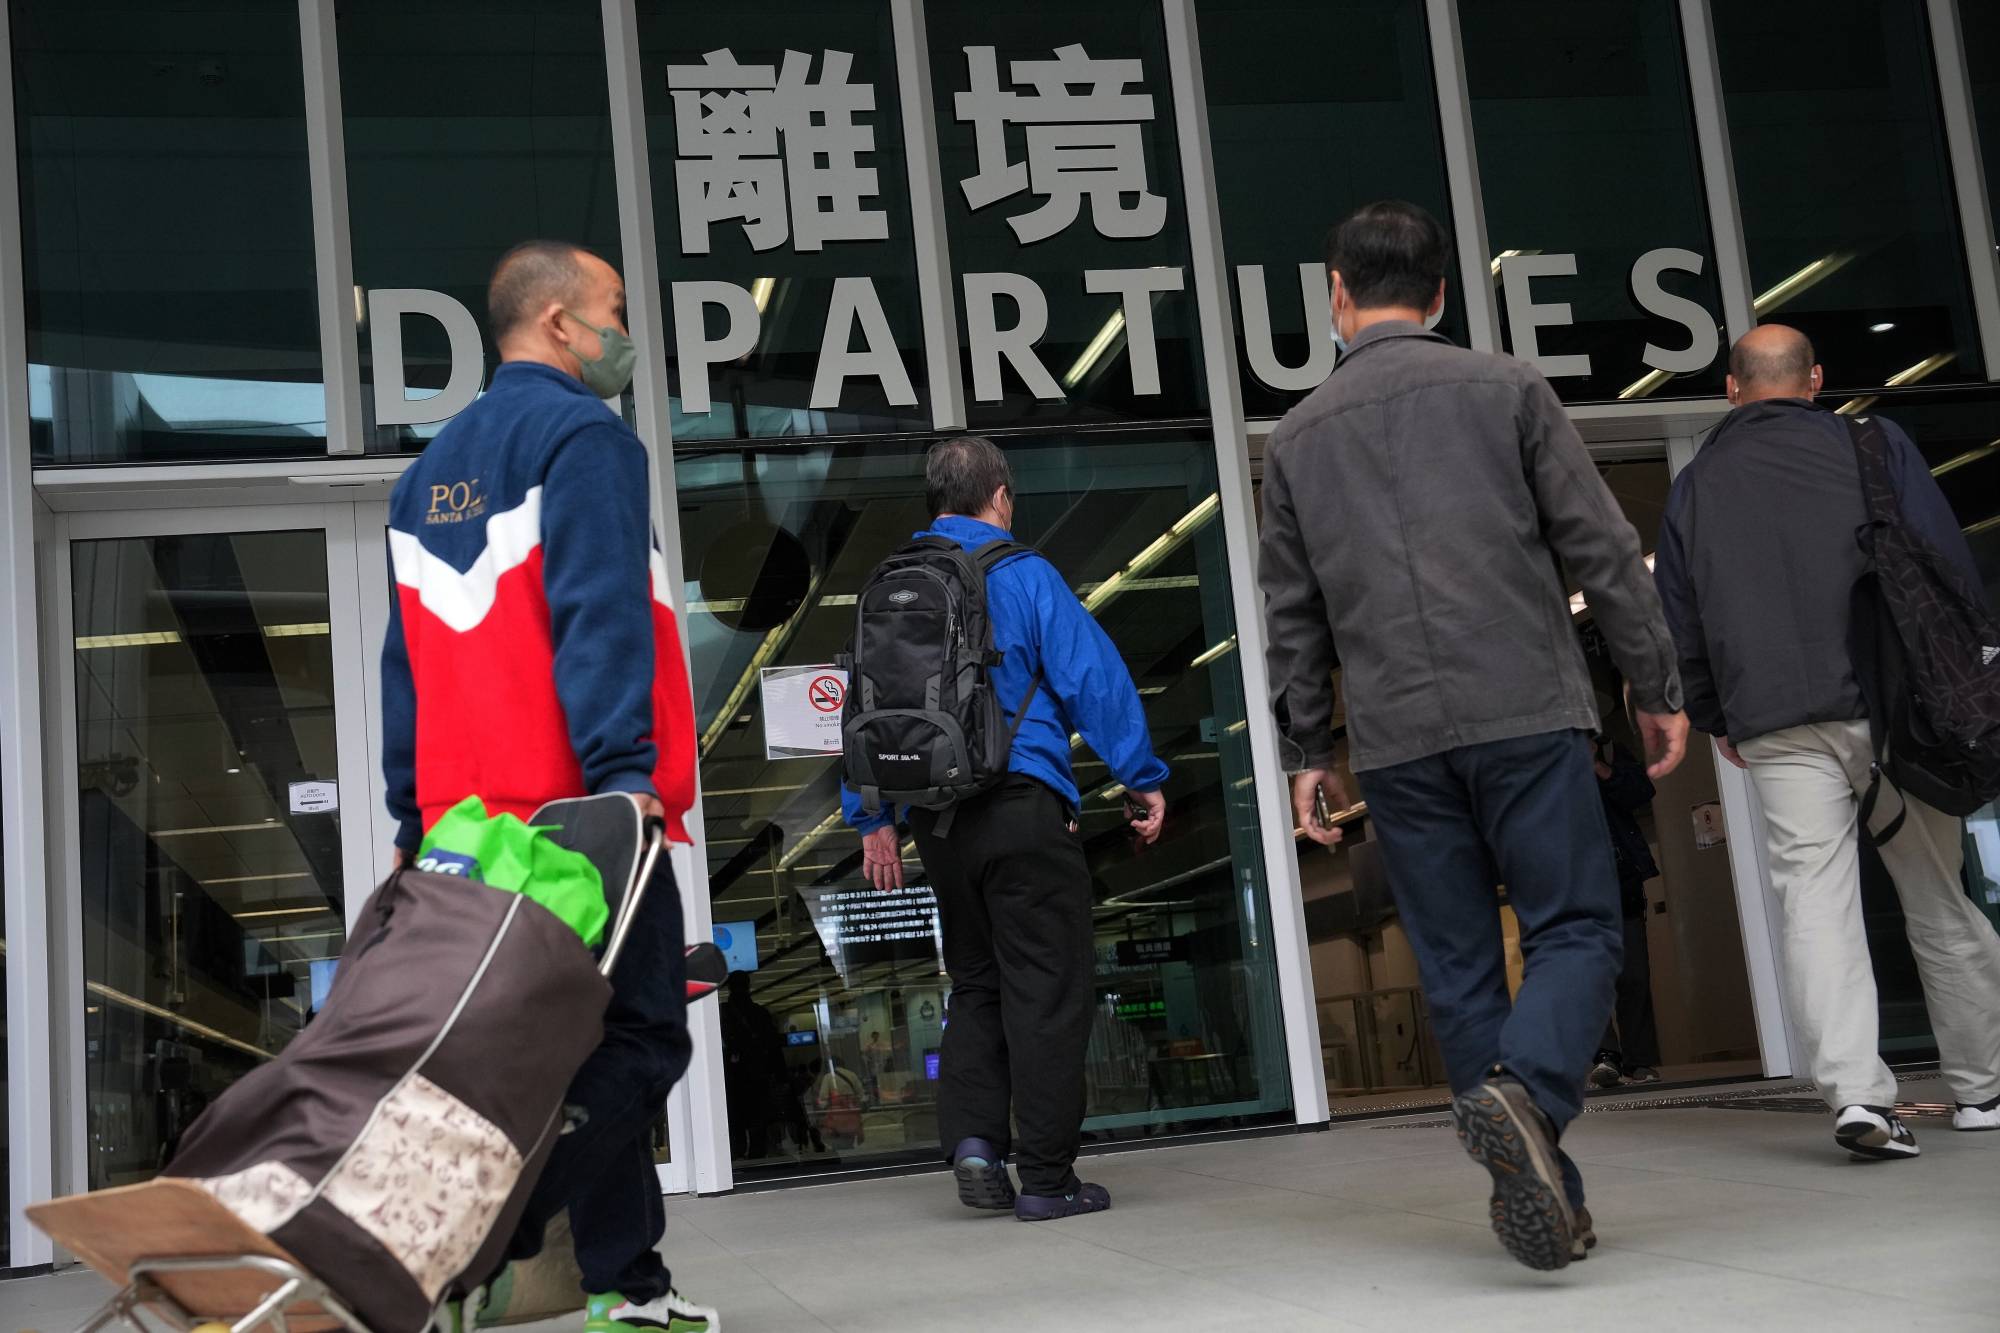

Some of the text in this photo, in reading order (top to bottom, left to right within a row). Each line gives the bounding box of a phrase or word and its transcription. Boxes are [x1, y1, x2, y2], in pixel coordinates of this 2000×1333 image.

[666, 42, 1168, 254] 離境
[368, 247, 1720, 426] DPARTUES
[425, 511, 464, 525] SANTA
